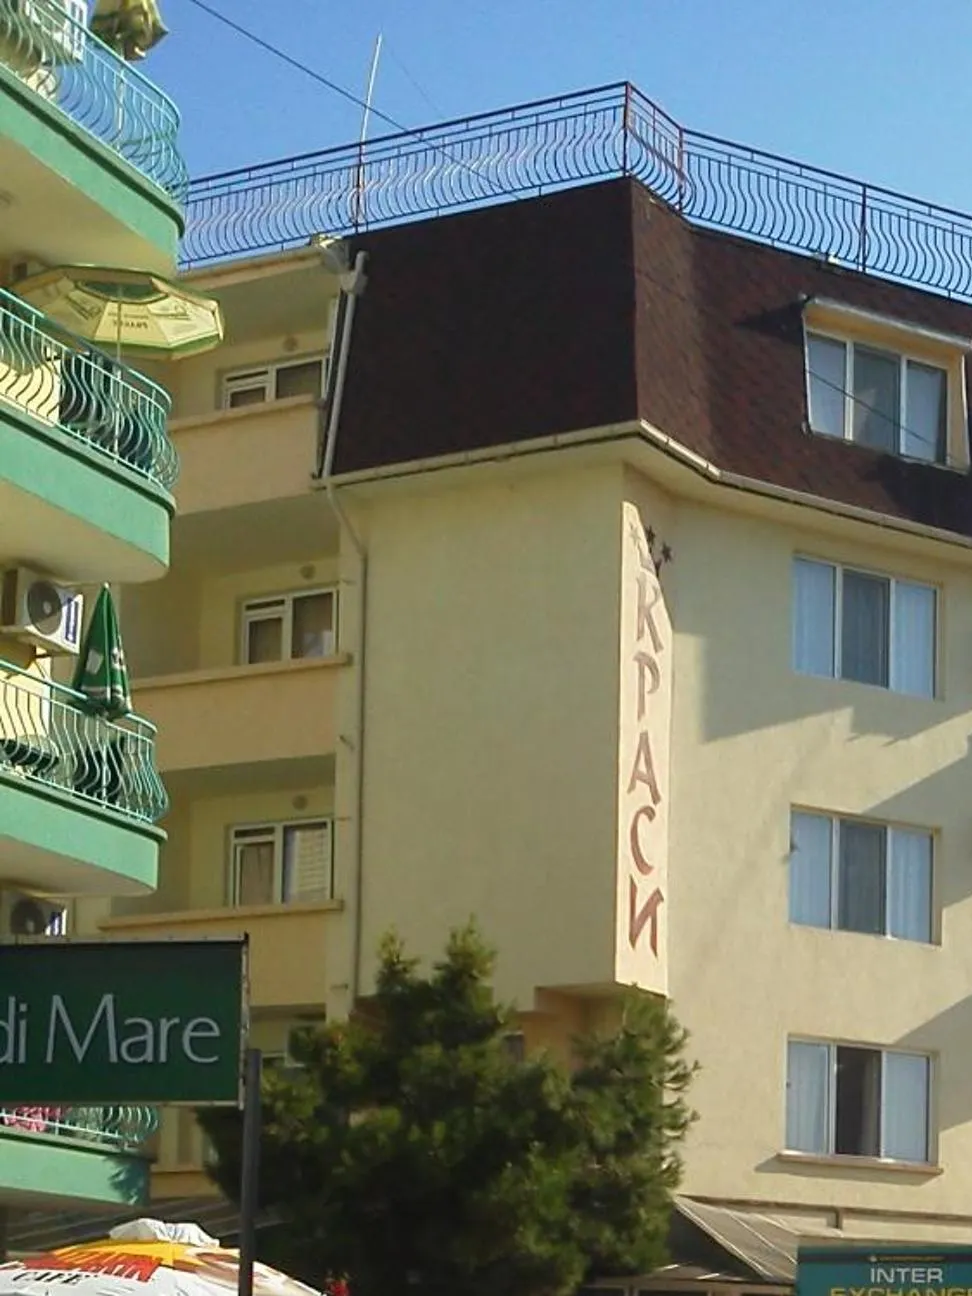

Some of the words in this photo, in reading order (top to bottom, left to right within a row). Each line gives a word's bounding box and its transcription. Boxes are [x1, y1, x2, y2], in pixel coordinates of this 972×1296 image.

[627, 574, 666, 958] КРАСИ
[46, 993, 221, 1063] Mare
[870, 1267, 944, 1283] INTER
